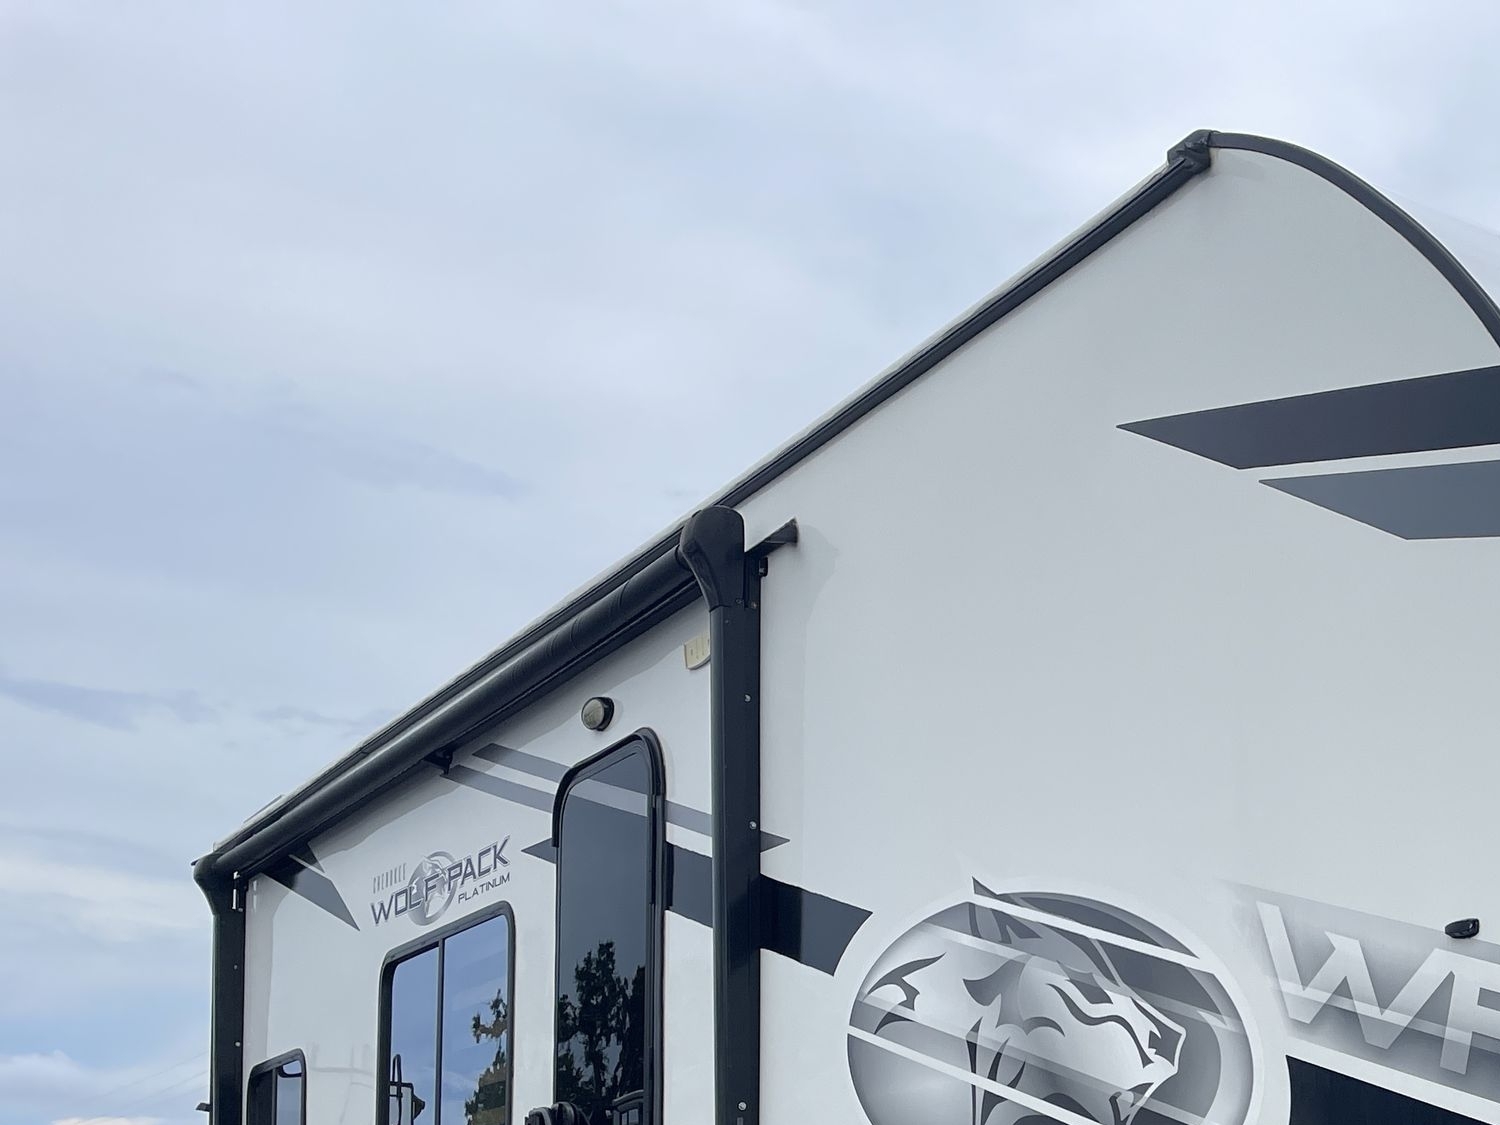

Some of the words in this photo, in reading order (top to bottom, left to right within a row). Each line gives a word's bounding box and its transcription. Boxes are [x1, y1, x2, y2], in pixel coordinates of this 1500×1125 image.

[370, 873, 440, 926] WOLF
[446, 835, 512, 892] PACK
[457, 872, 511, 904] PLATINUM
